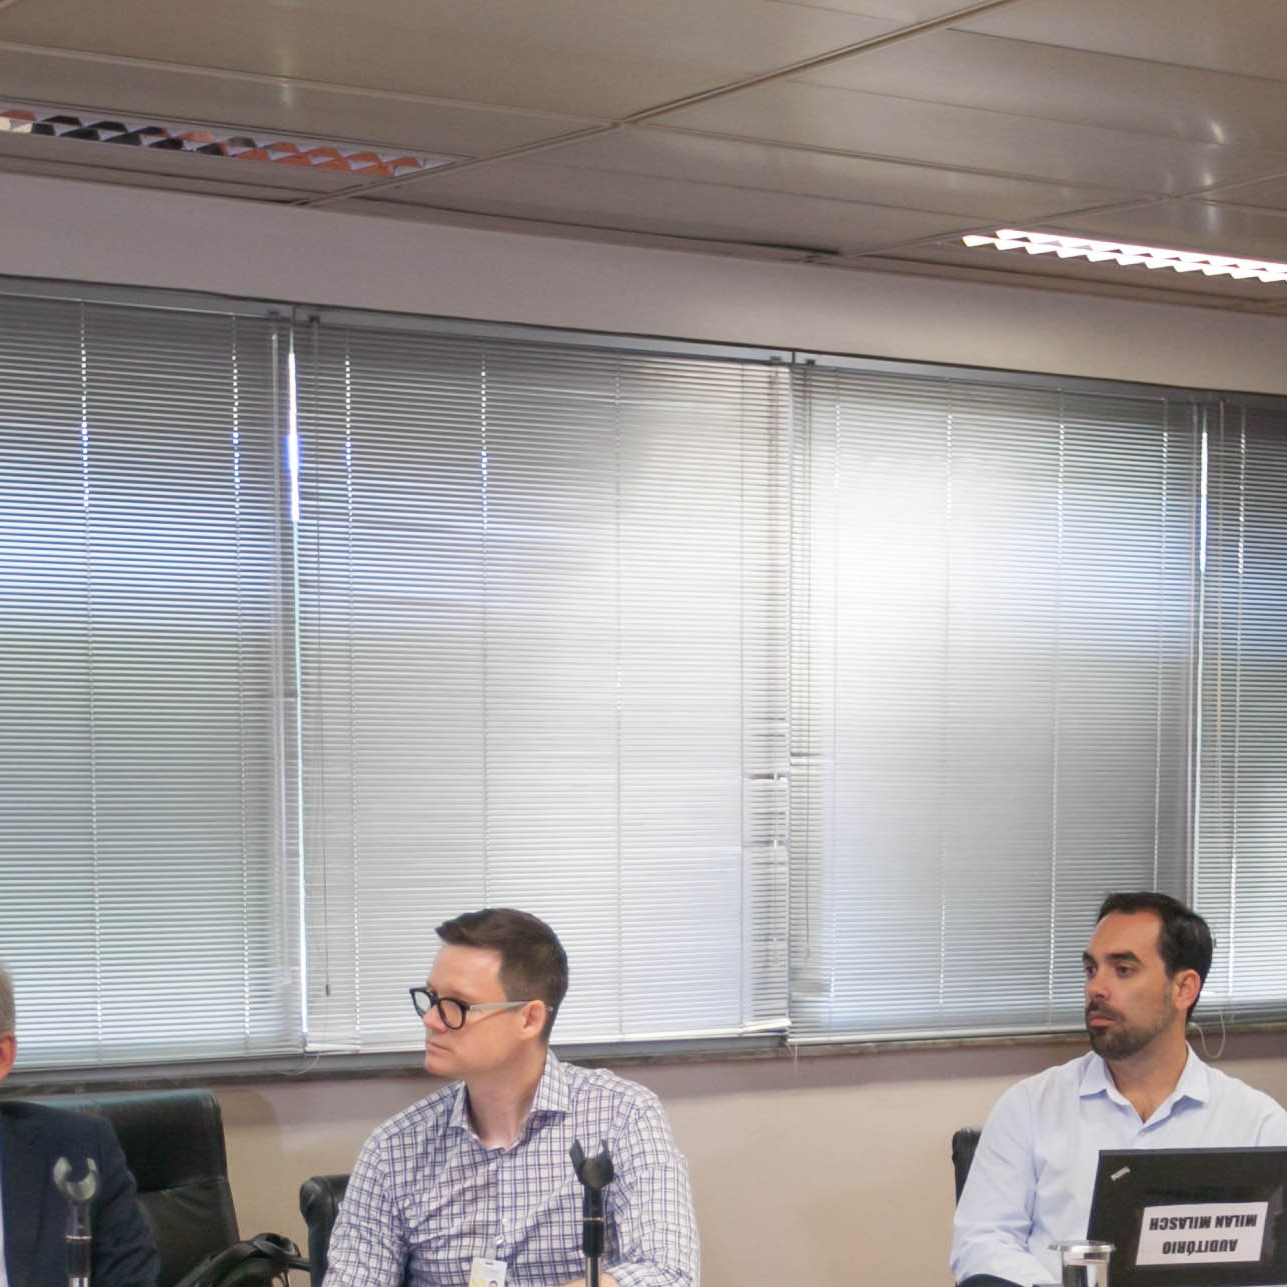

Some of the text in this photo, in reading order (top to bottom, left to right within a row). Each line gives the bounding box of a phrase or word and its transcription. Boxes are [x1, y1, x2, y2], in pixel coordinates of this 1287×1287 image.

[1149, 1214, 1258, 1231] MILAN MILASCH
[1162, 1239, 1239, 1256] AUDITÓRIO
